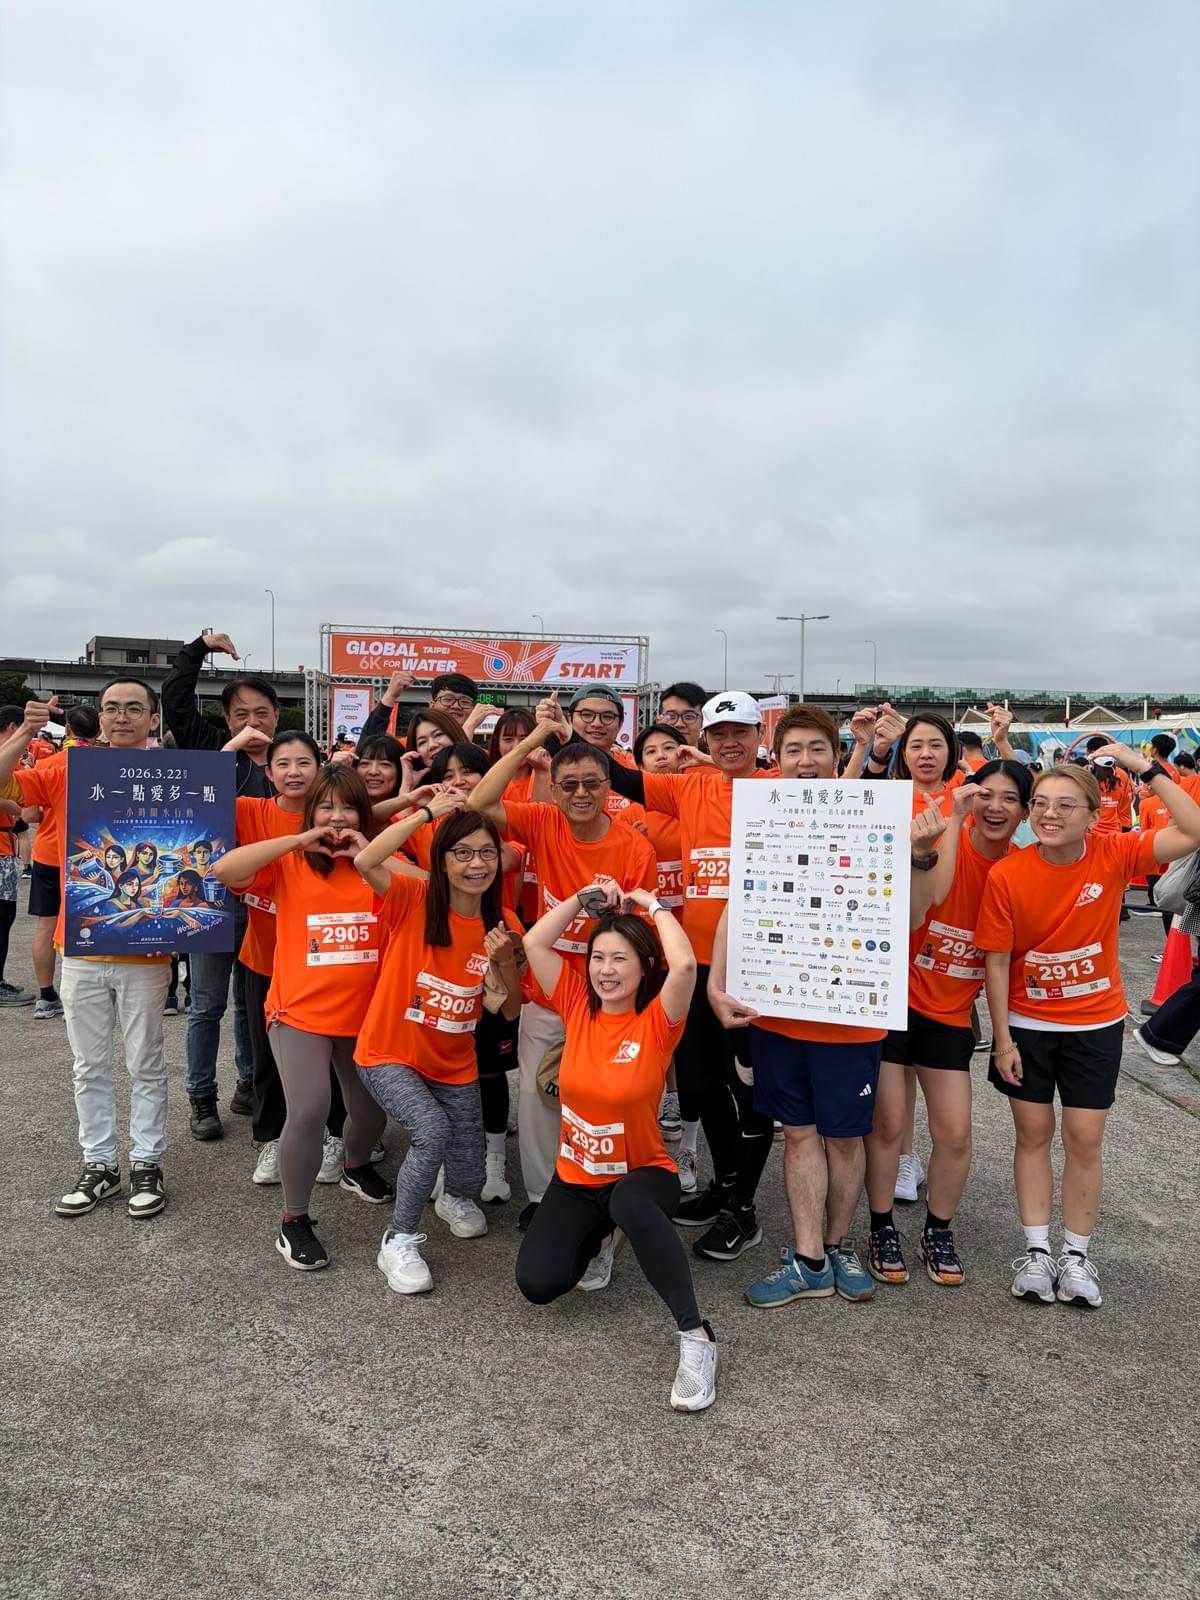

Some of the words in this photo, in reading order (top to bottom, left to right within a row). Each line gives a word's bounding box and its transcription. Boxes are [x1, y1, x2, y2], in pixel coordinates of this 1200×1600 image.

[346, 640, 418, 657] GLOBAL
[423, 646, 450, 654] TAIPEI
[360, 656, 382, 670] 6K
[383, 660, 400, 668] FOR
[402, 659, 458, 672] WATER
[559, 662, 626, 679] START
[120, 767, 182, 779] 2026.3.22
[88, 783, 216, 803] 水一點愛多一點
[768, 788, 875, 806] 水一點愛多一點
[321, 925, 370, 944] 2905
[465, 958, 485, 973] 6K
[1038, 959, 1096, 981] 2913
[426, 990, 476, 1015] 2908
[571, 1126, 614, 1155] 2920
